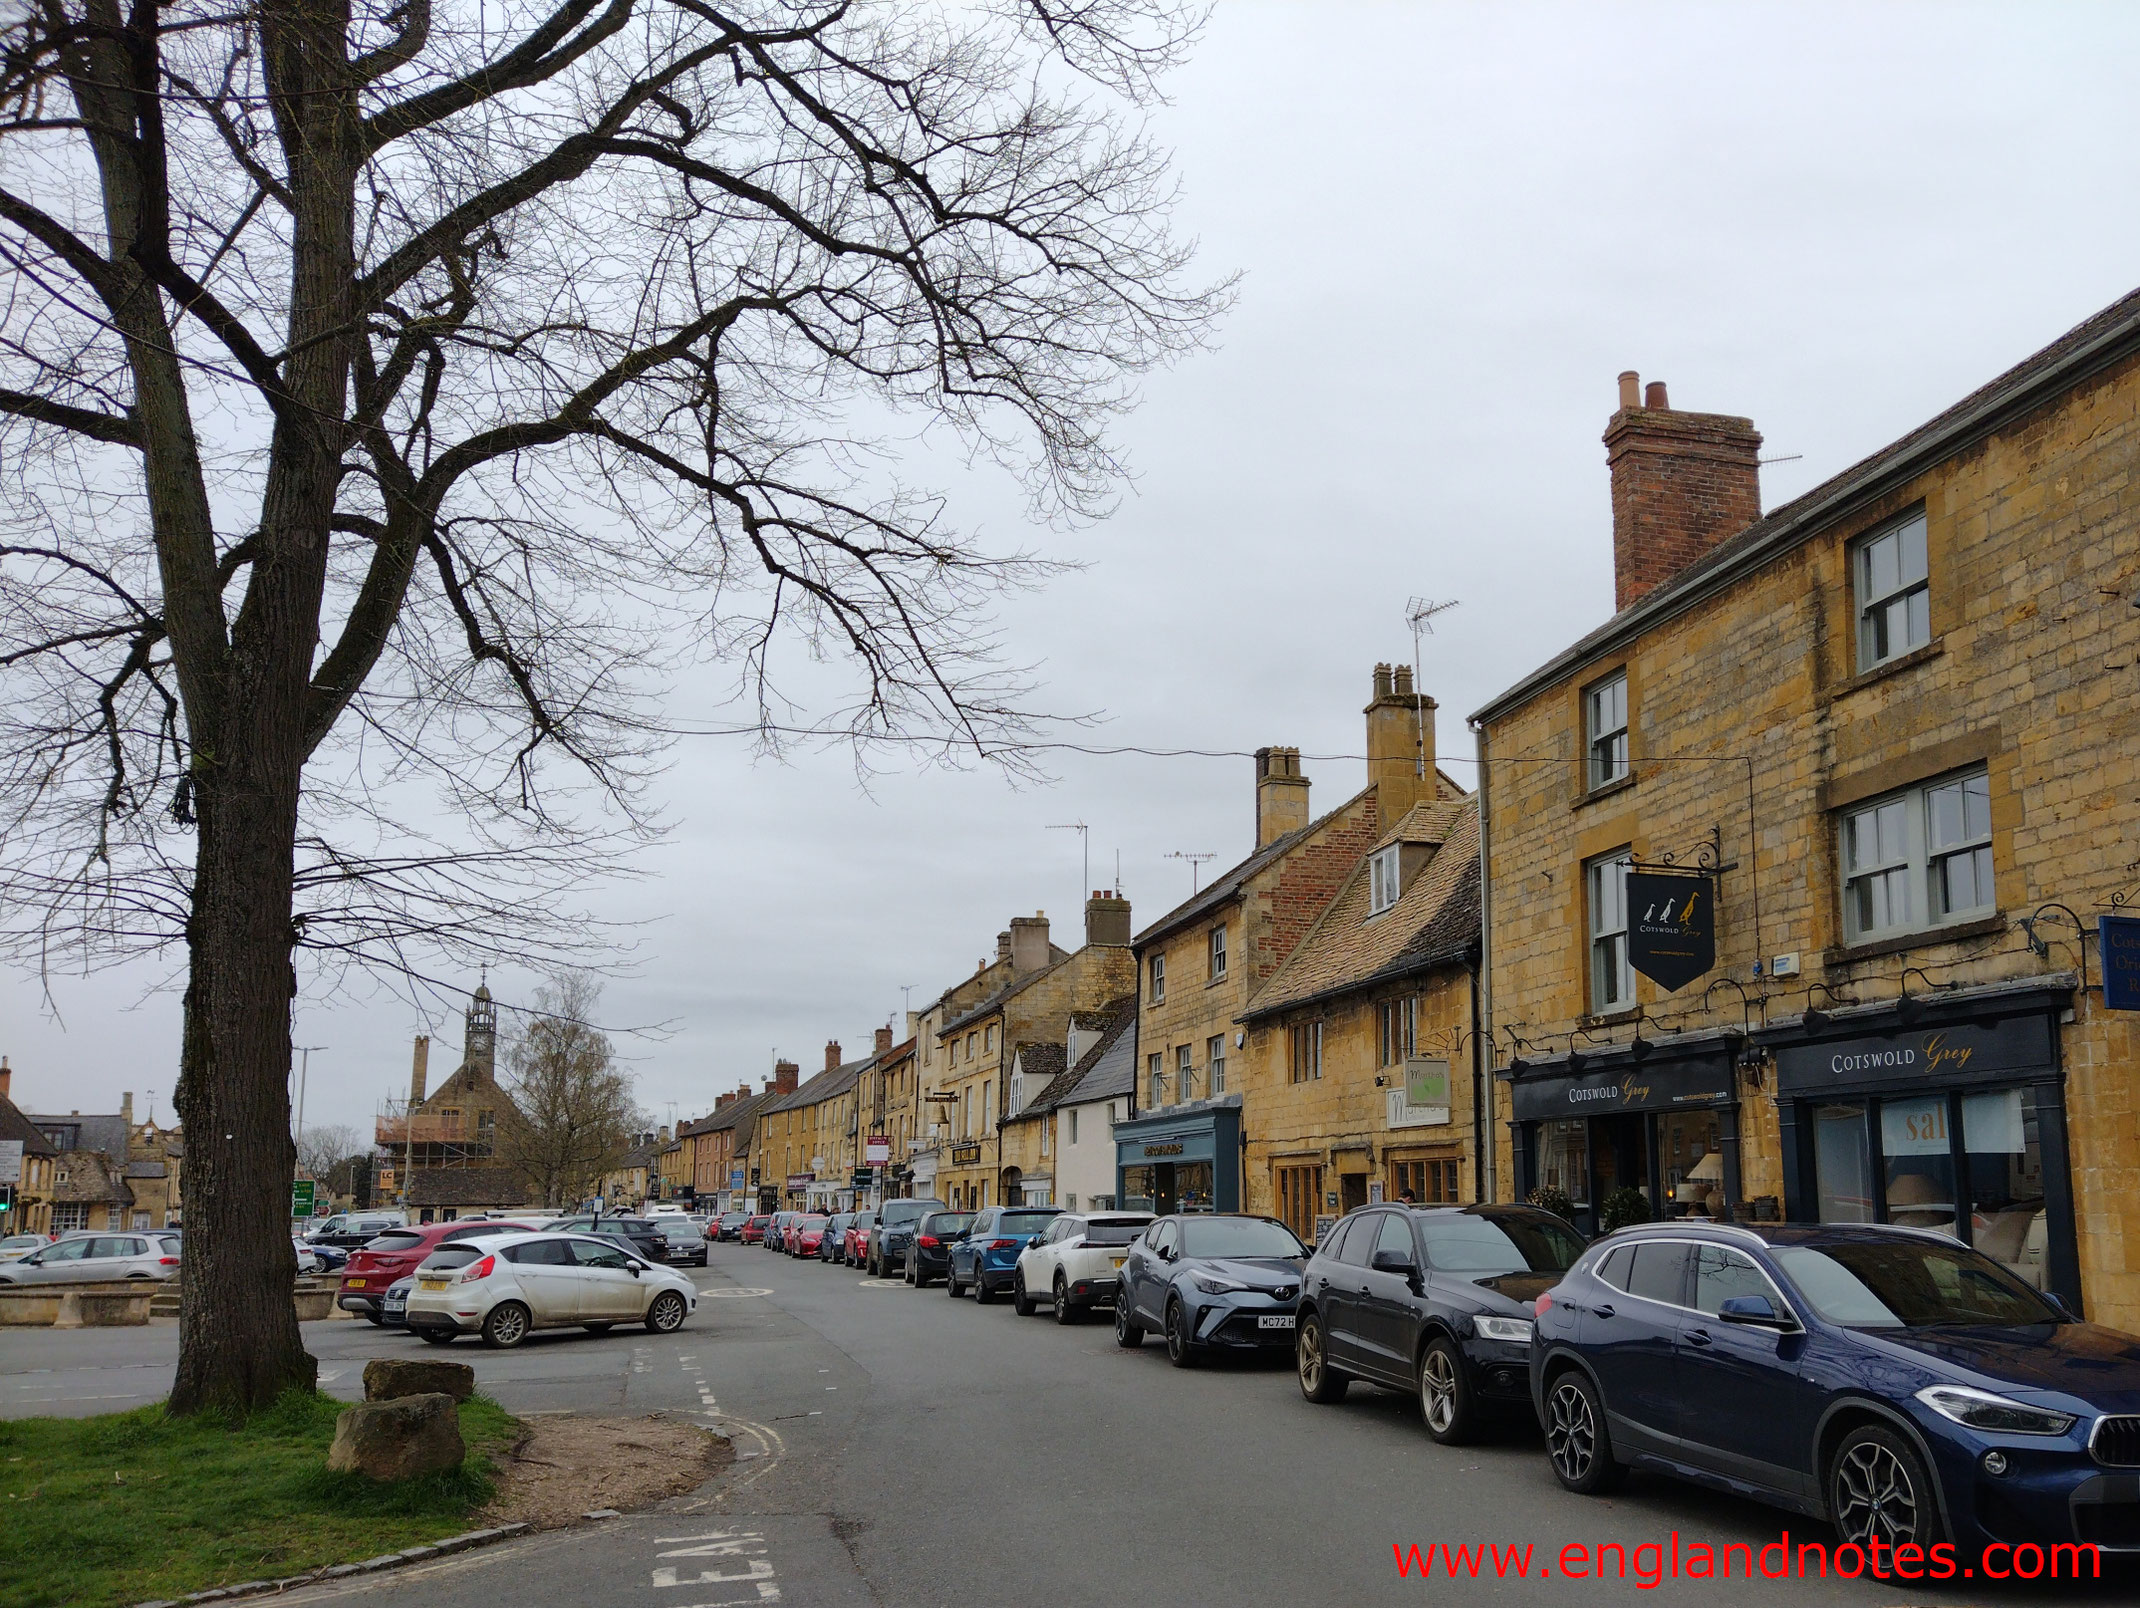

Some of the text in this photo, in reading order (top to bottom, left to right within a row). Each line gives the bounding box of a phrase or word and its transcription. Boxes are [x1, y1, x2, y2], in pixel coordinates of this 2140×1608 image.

[1831, 1031, 1973, 1074] COTSWOLD Grey
[1569, 1072, 1651, 1105] COTSWOLD Grey
[1262, 1317, 1286, 1327] MC72
